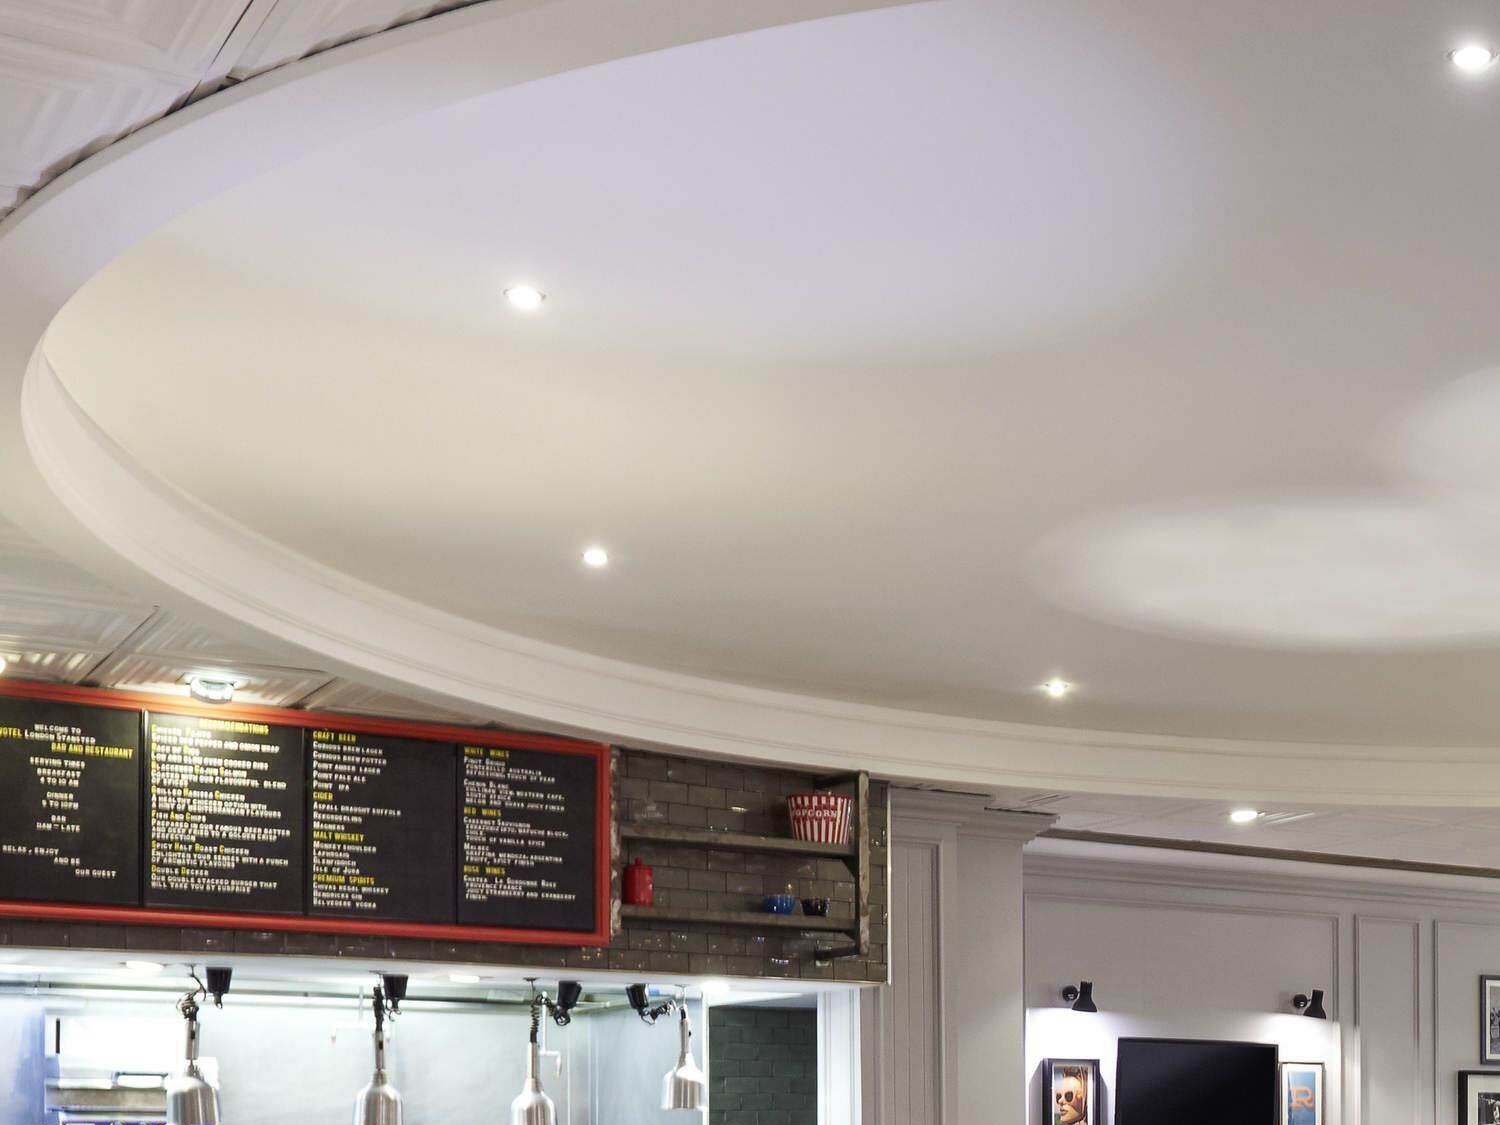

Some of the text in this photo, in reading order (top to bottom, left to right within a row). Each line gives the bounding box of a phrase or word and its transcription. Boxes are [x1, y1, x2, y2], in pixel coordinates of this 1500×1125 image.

[34, 724, 81, 735] WELCOME TO
[24, 729, 55, 741] LONDON
[56, 732, 96, 745] STANSTED
[313, 731, 334, 742] CRAFT
[51, 742, 133, 759] BAR AND RESTAURANT
[30, 756, 85, 770] SERVING TIMES
[36, 767, 81, 779] BREAKFAST
[47, 777, 57, 786] TO
[68, 779, 79, 787] AM
[47, 791, 73, 801] DINNER
[313, 791, 333, 801] CIDER
[49, 800, 59, 809] TO
[51, 815, 66, 823] BAR
[61, 824, 80, 833] LATE
[313, 830, 332, 840] MALT
[34, 847, 59, 856] ENJOY
[54, 857, 69, 865] AND
[75, 868, 117, 879] OUR GUEST
[313, 873, 374, 886] PREMIUM SPIRITS
[1288, 1087, 1313, 1109] R
